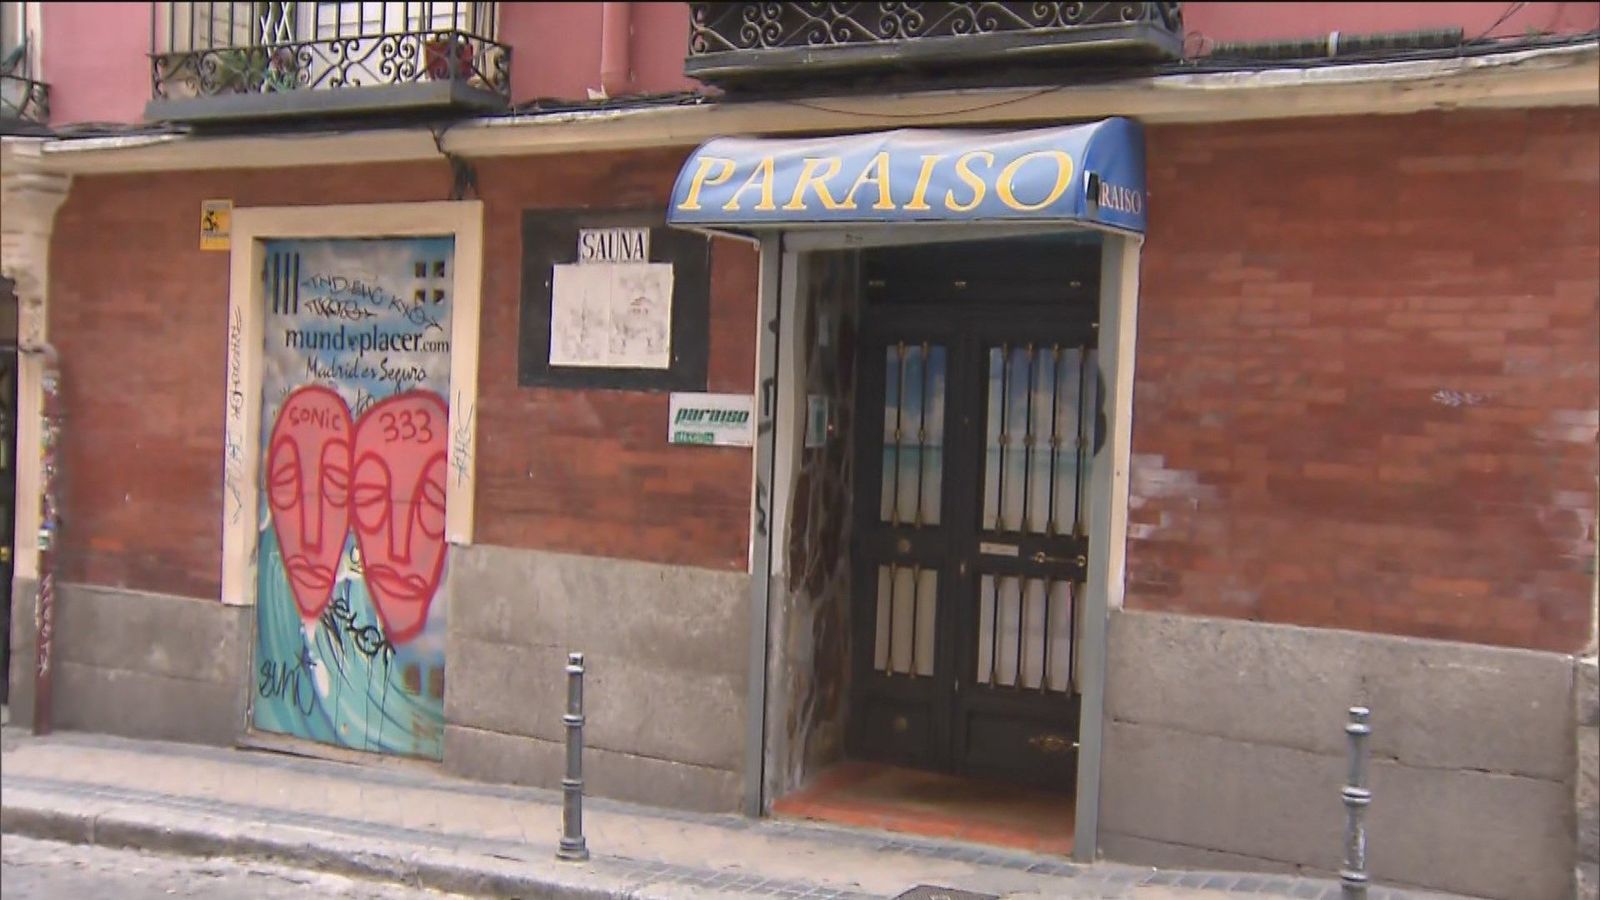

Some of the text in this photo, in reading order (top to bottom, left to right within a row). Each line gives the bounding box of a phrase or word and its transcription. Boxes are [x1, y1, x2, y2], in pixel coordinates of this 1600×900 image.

[677, 150, 1075, 212] PARAISO
[1099, 182, 1142, 215] RAISO
[581, 231, 646, 260] SAUNA
[305, 355, 359, 380] Madrid
[379, 357, 428, 391] Seguro
[379, 408, 434, 444] 333
[674, 407, 750, 425] paraiso
